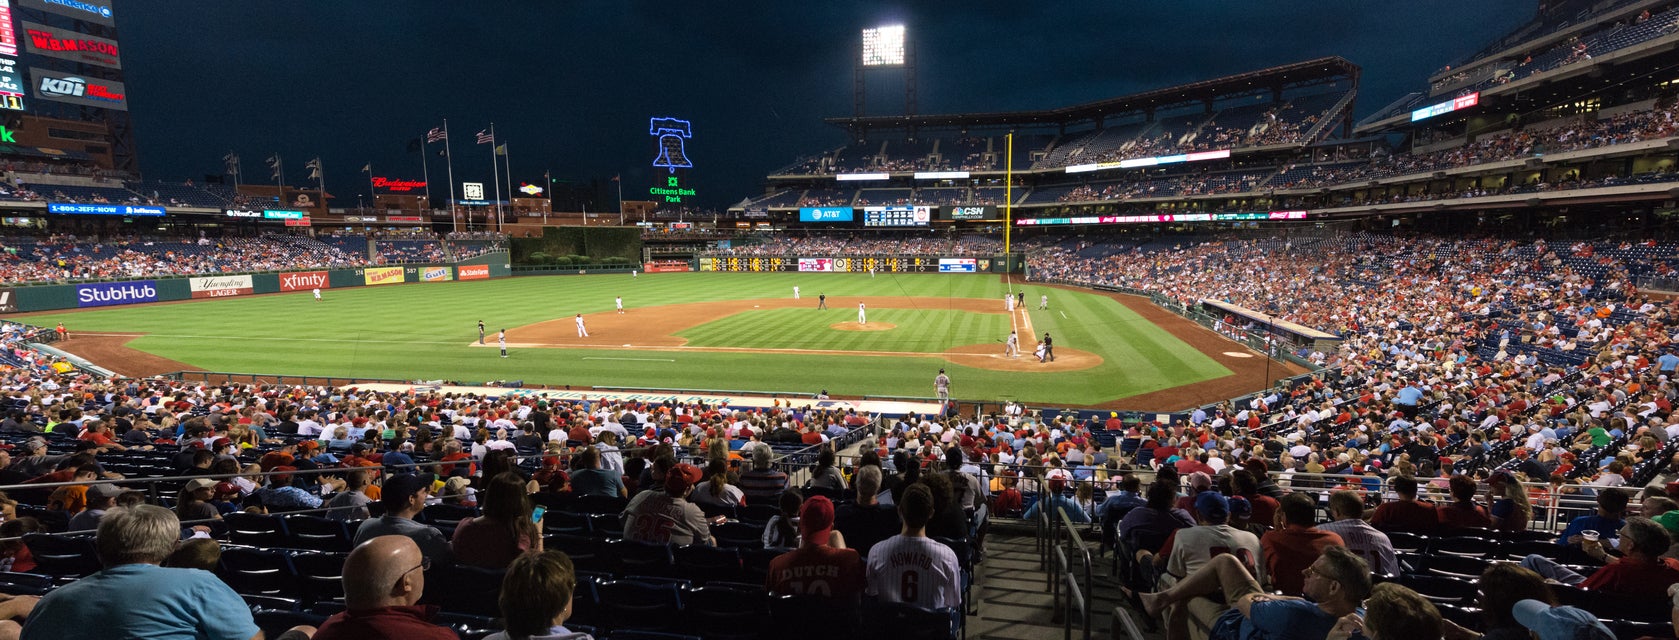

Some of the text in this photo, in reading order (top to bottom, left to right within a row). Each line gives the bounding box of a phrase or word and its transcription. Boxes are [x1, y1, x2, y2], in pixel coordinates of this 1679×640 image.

[372, 177, 427, 188] Budweiser
[650, 187, 696, 196] Citizens Bank
[52, 205, 116, 213] 1-800-JEFF-NOW
[233, 210, 261, 218] NovaCare
[823, 210, 841, 218] AT&T
[964, 207, 984, 215] CSN
[425, 269, 446, 279] Gulf
[200, 278, 245, 289] Yuengling
[283, 273, 326, 290] xfinity
[79, 285, 156, 302] StubHub
[210, 289, 238, 297] LAGER
[890, 551, 932, 570] HOWARD
[782, 564, 840, 580] DUTCH
[901, 570, 918, 602] 6
